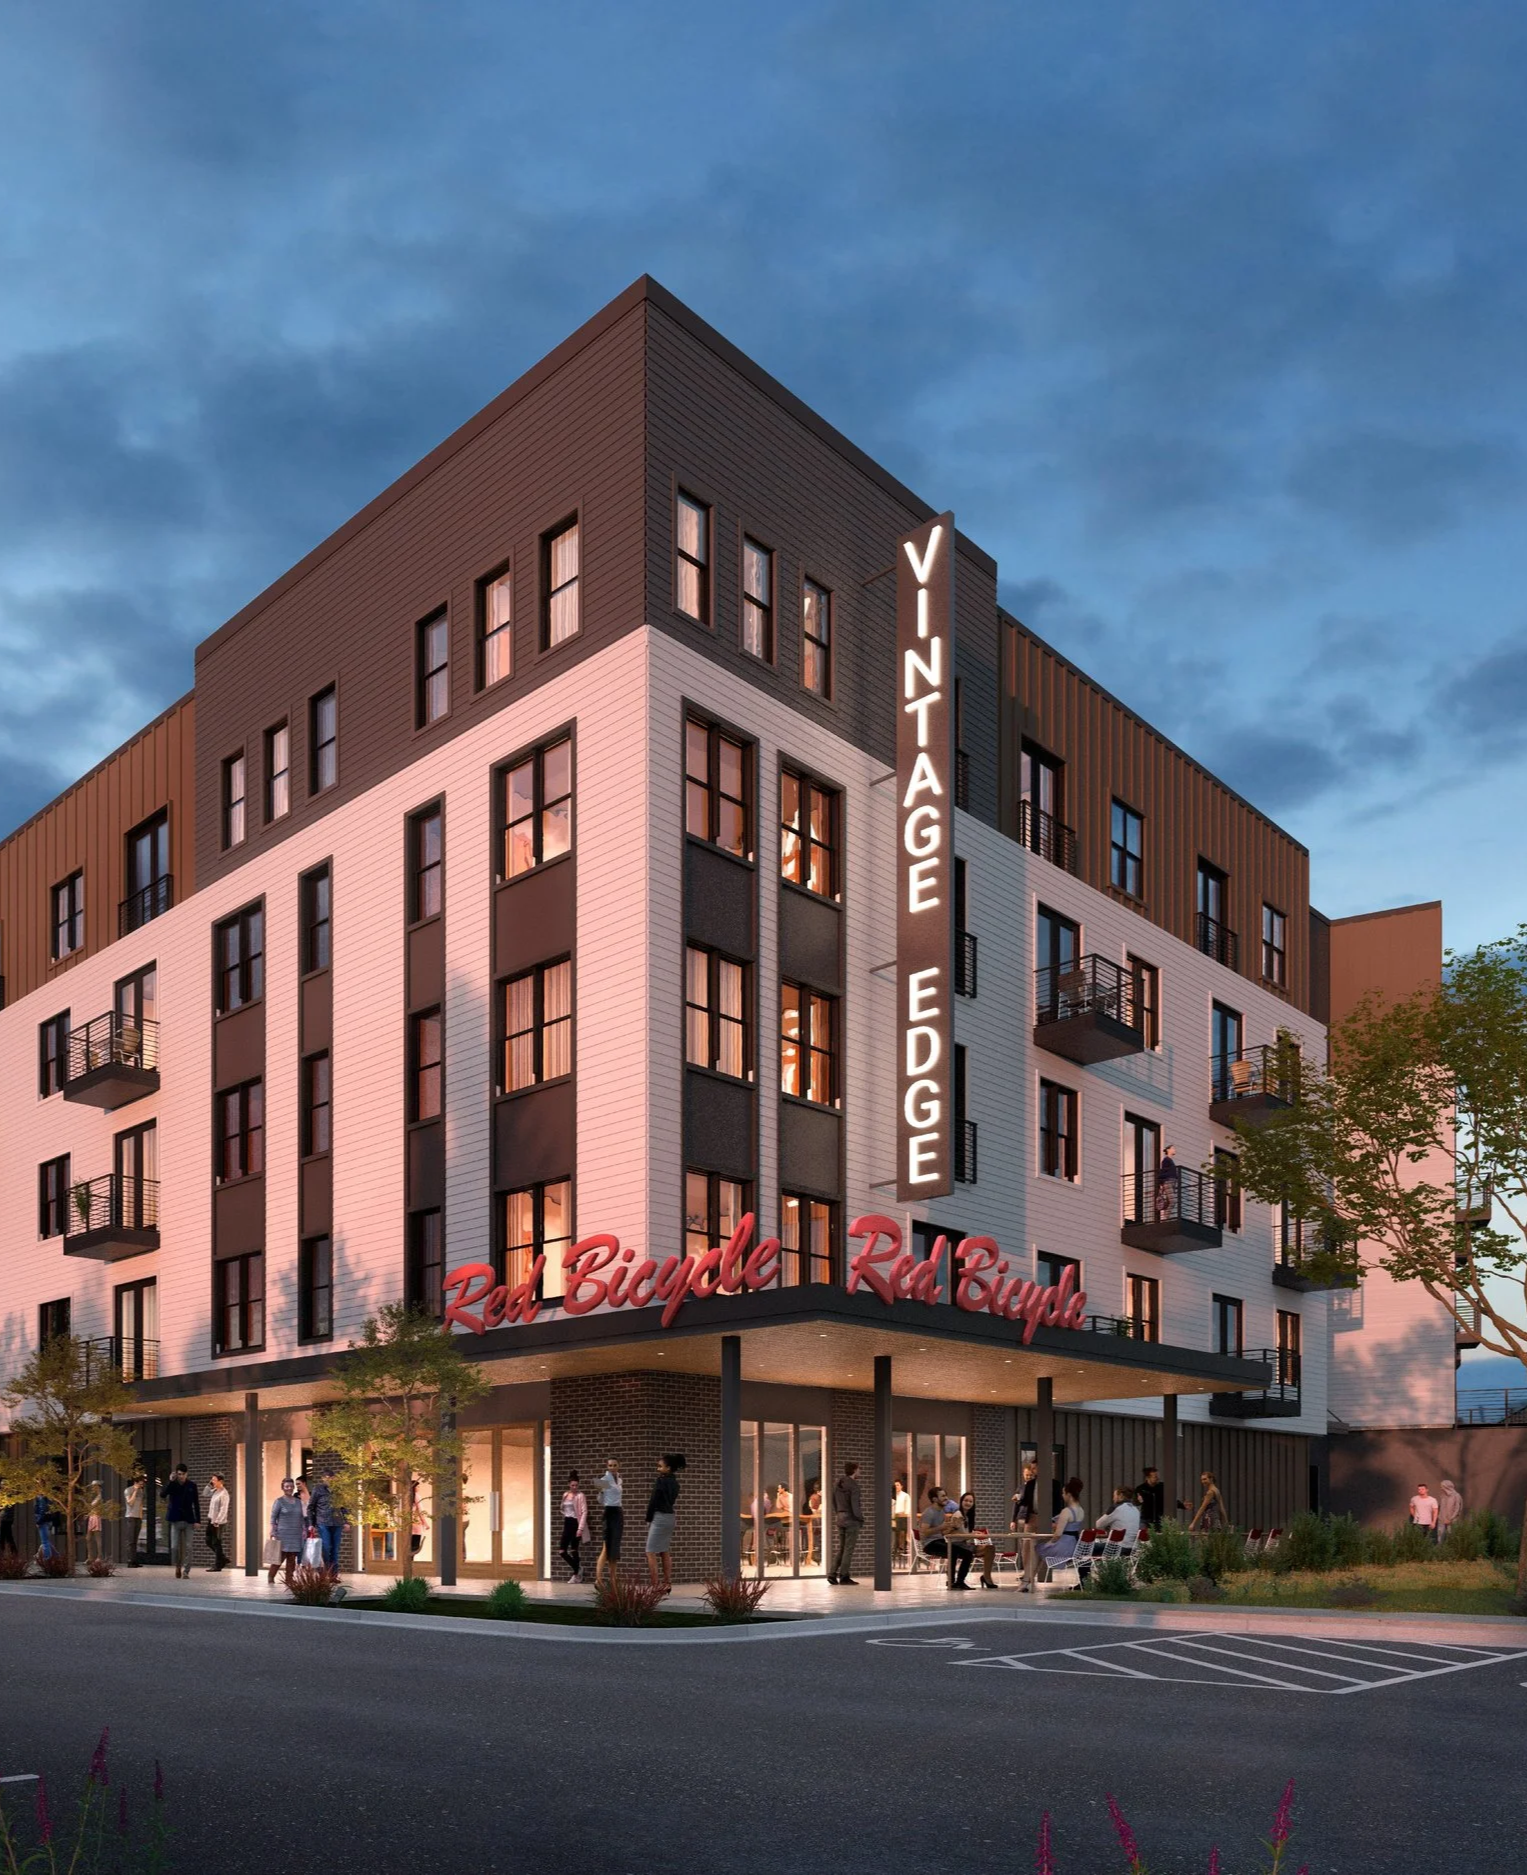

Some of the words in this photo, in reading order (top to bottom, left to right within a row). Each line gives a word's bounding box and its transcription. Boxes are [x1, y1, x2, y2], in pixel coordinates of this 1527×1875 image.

[903, 525, 944, 915] VINTAGE
[903, 967, 942, 1185] EDGE
[443, 1254, 547, 1335] Red
[562, 1212, 782, 1329] Bicycle
[846, 1214, 947, 1306] Red
[956, 1235, 1088, 1346] Bicycle
